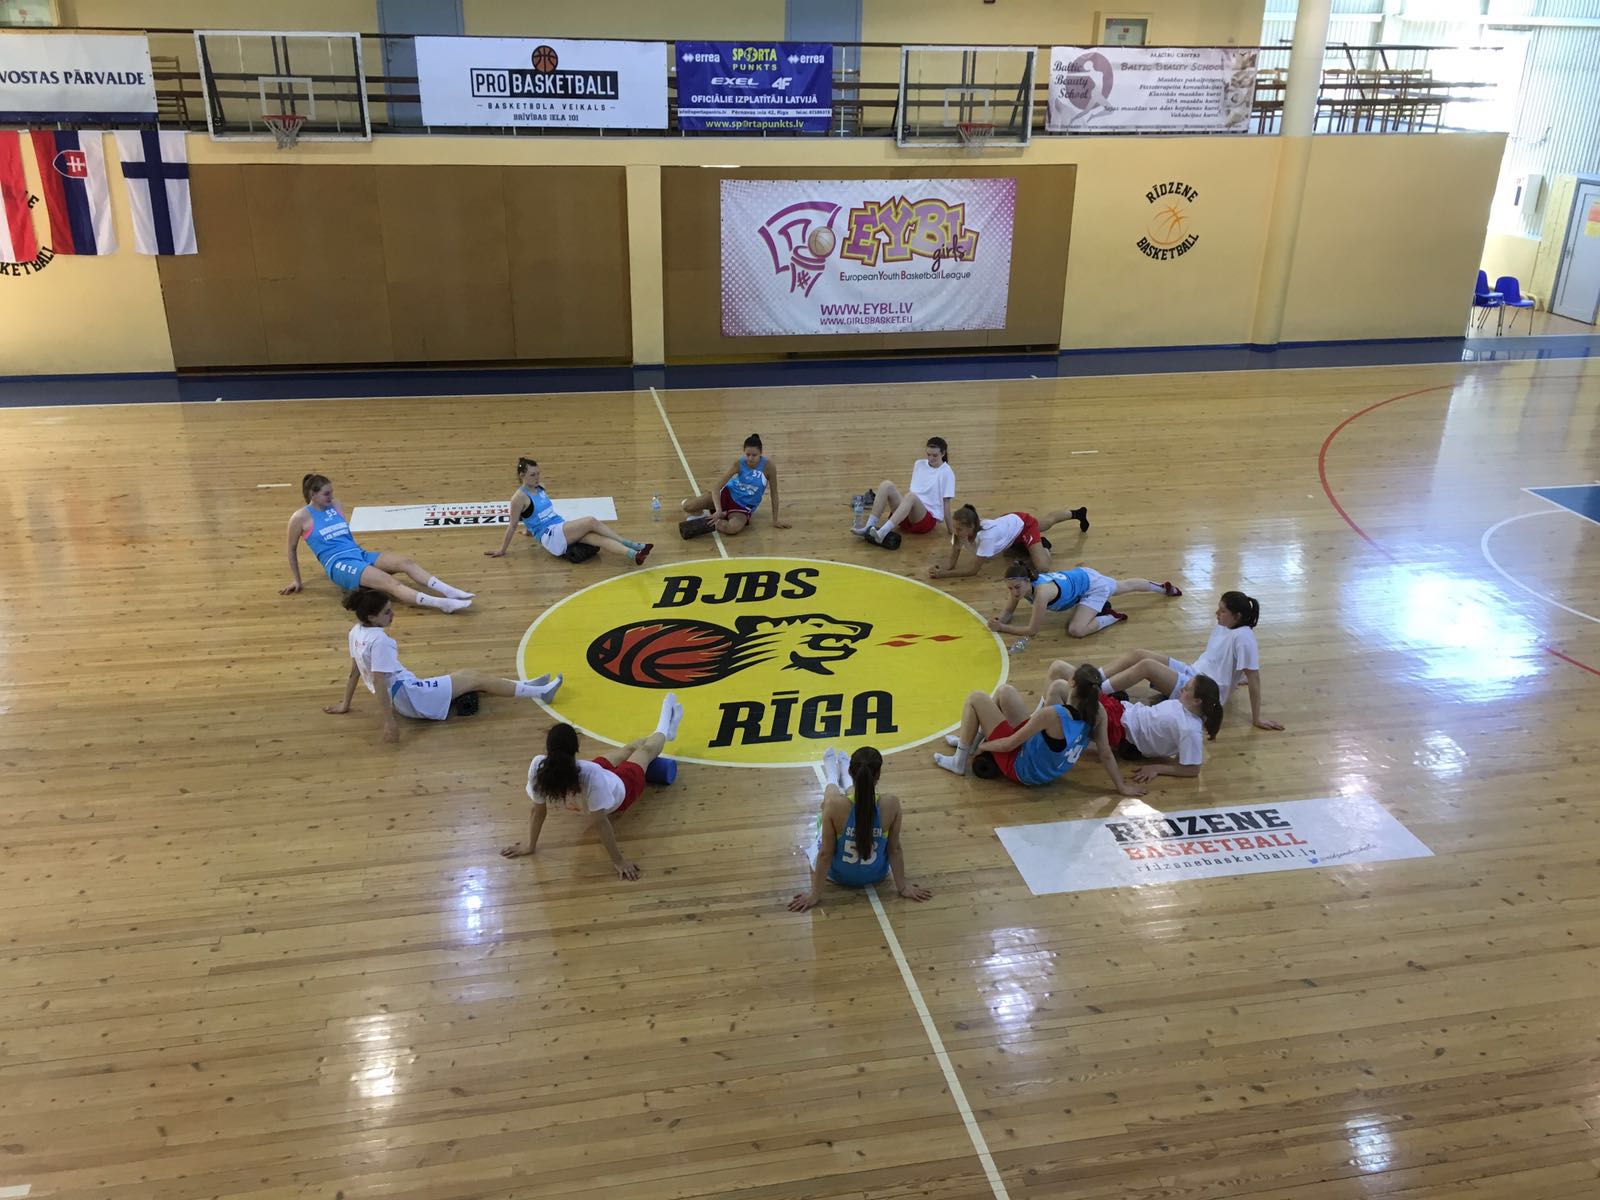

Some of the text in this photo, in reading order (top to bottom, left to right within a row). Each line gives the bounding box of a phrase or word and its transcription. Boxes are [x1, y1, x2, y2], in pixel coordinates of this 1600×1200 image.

[695, 53, 720, 63] errea
[732, 47, 777, 62] SPORTA
[800, 54, 825, 64] errea
[1053, 60, 1081, 72] Baltic
[64, 69, 146, 85] PĀRVALDE
[475, 73, 616, 95] PRO BASKETBALL
[711, 77, 759, 86] EXEL
[772, 77, 792, 90] 4F
[1054, 74, 1089, 88] Beauty
[691, 95, 818, 105] OFICIĀLIE IZPLATĪTĀJI LATVIJĀ
[1058, 88, 1089, 99] School
[513, 112, 548, 121] BRĪVĪBAS
[550, 113, 566, 121] IELA
[705, 119, 804, 130] www.sportapunkts.lv
[1145, 181, 1199, 204] RĪDZENE
[840, 195, 980, 267] EYBL
[931, 234, 966, 272] girls
[1136, 233, 1200, 260] BASKETBALL
[840, 270, 971, 282] European Youth Basketball League
[820, 302, 913, 316] WWW.EYBL.LV
[819, 315, 913, 326] WWW.GIRLSBASKET.EU
[651, 568, 820, 609] BJBS
[707, 690, 898, 748] RĪGA
[1123, 832, 1308, 861] BASKETBALL
